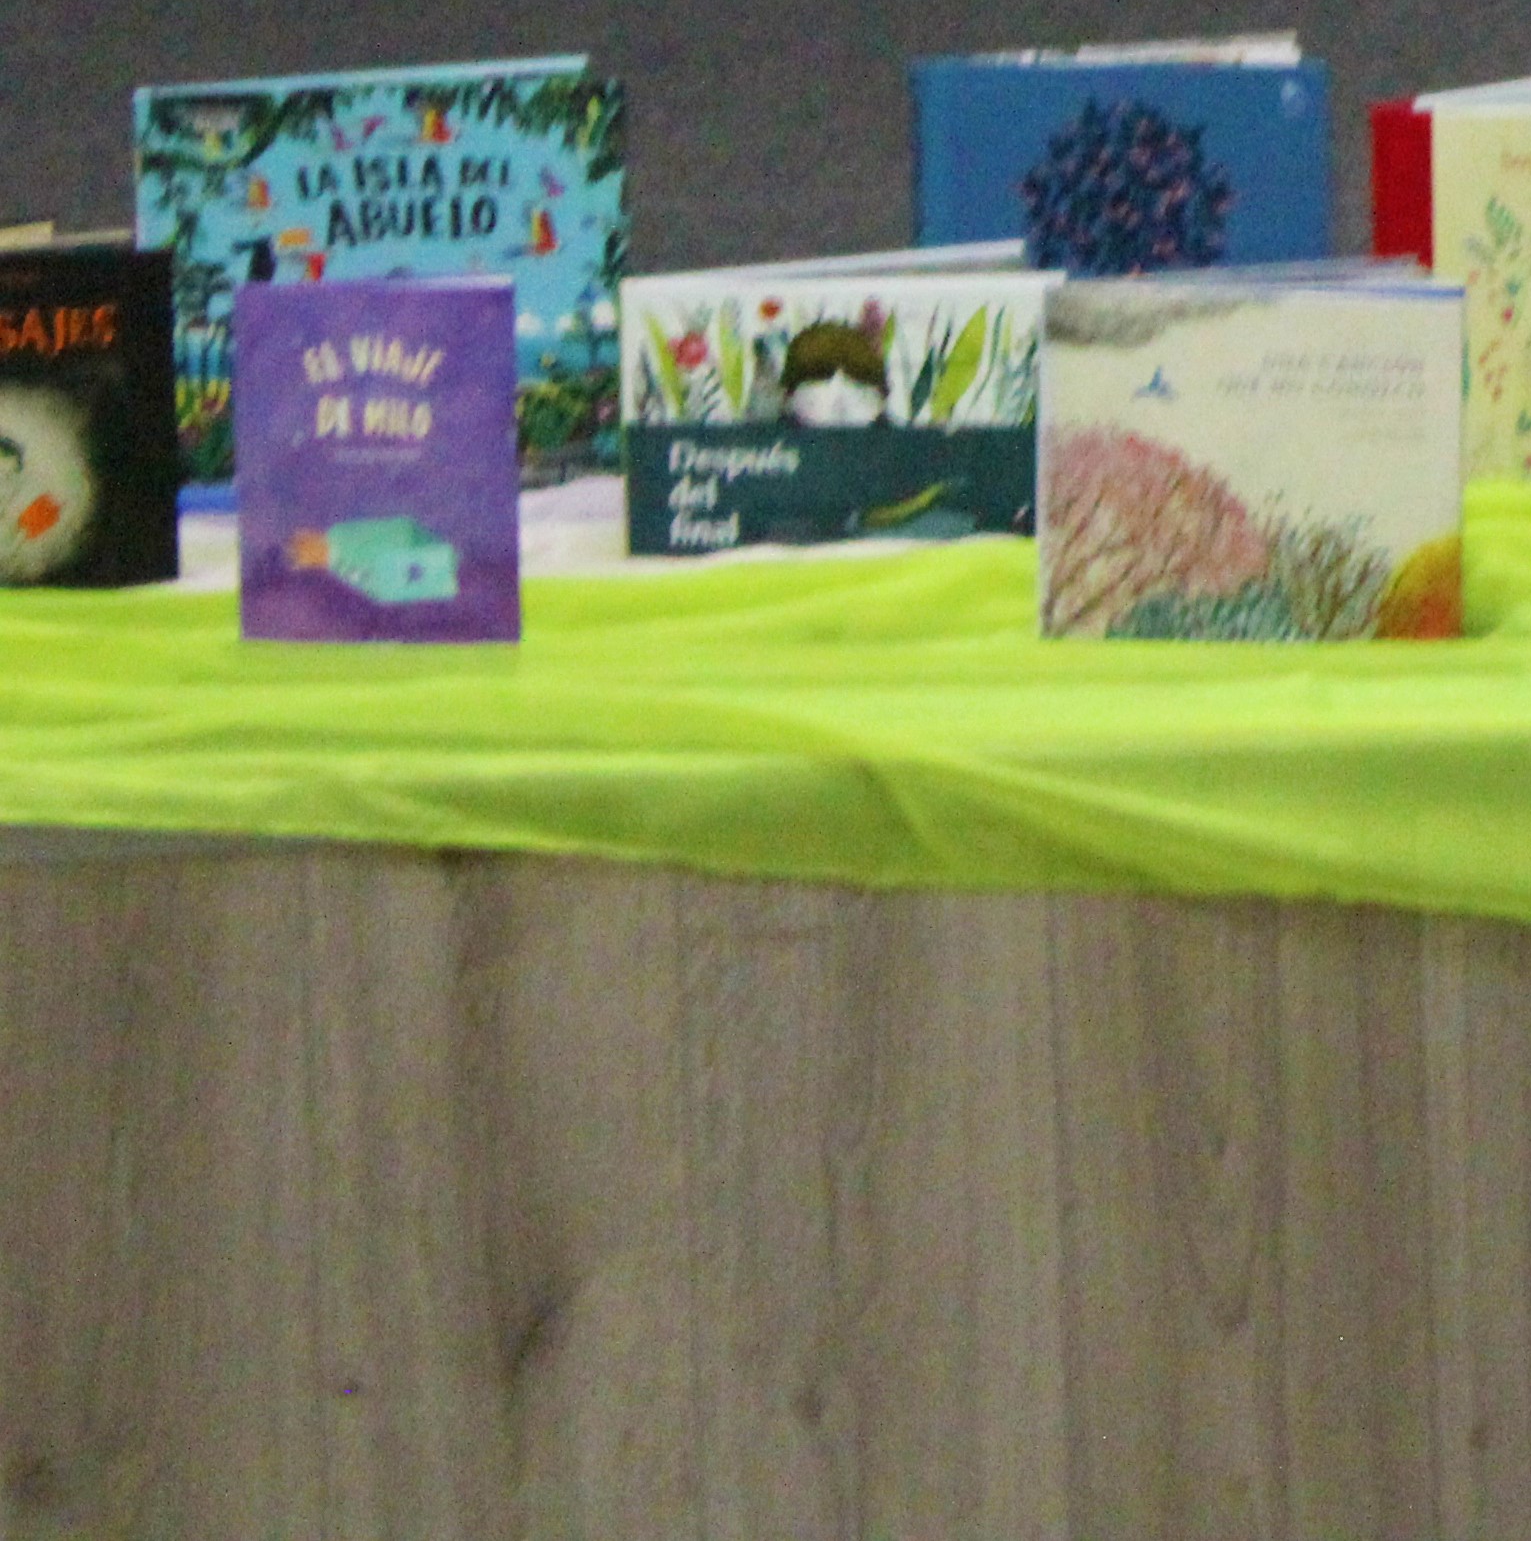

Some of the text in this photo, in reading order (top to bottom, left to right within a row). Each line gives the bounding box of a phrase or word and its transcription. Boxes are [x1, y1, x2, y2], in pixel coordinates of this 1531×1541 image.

[297, 162, 339, 201] LA
[354, 154, 443, 193] ISLA
[325, 194, 498, 247] ABUELO
